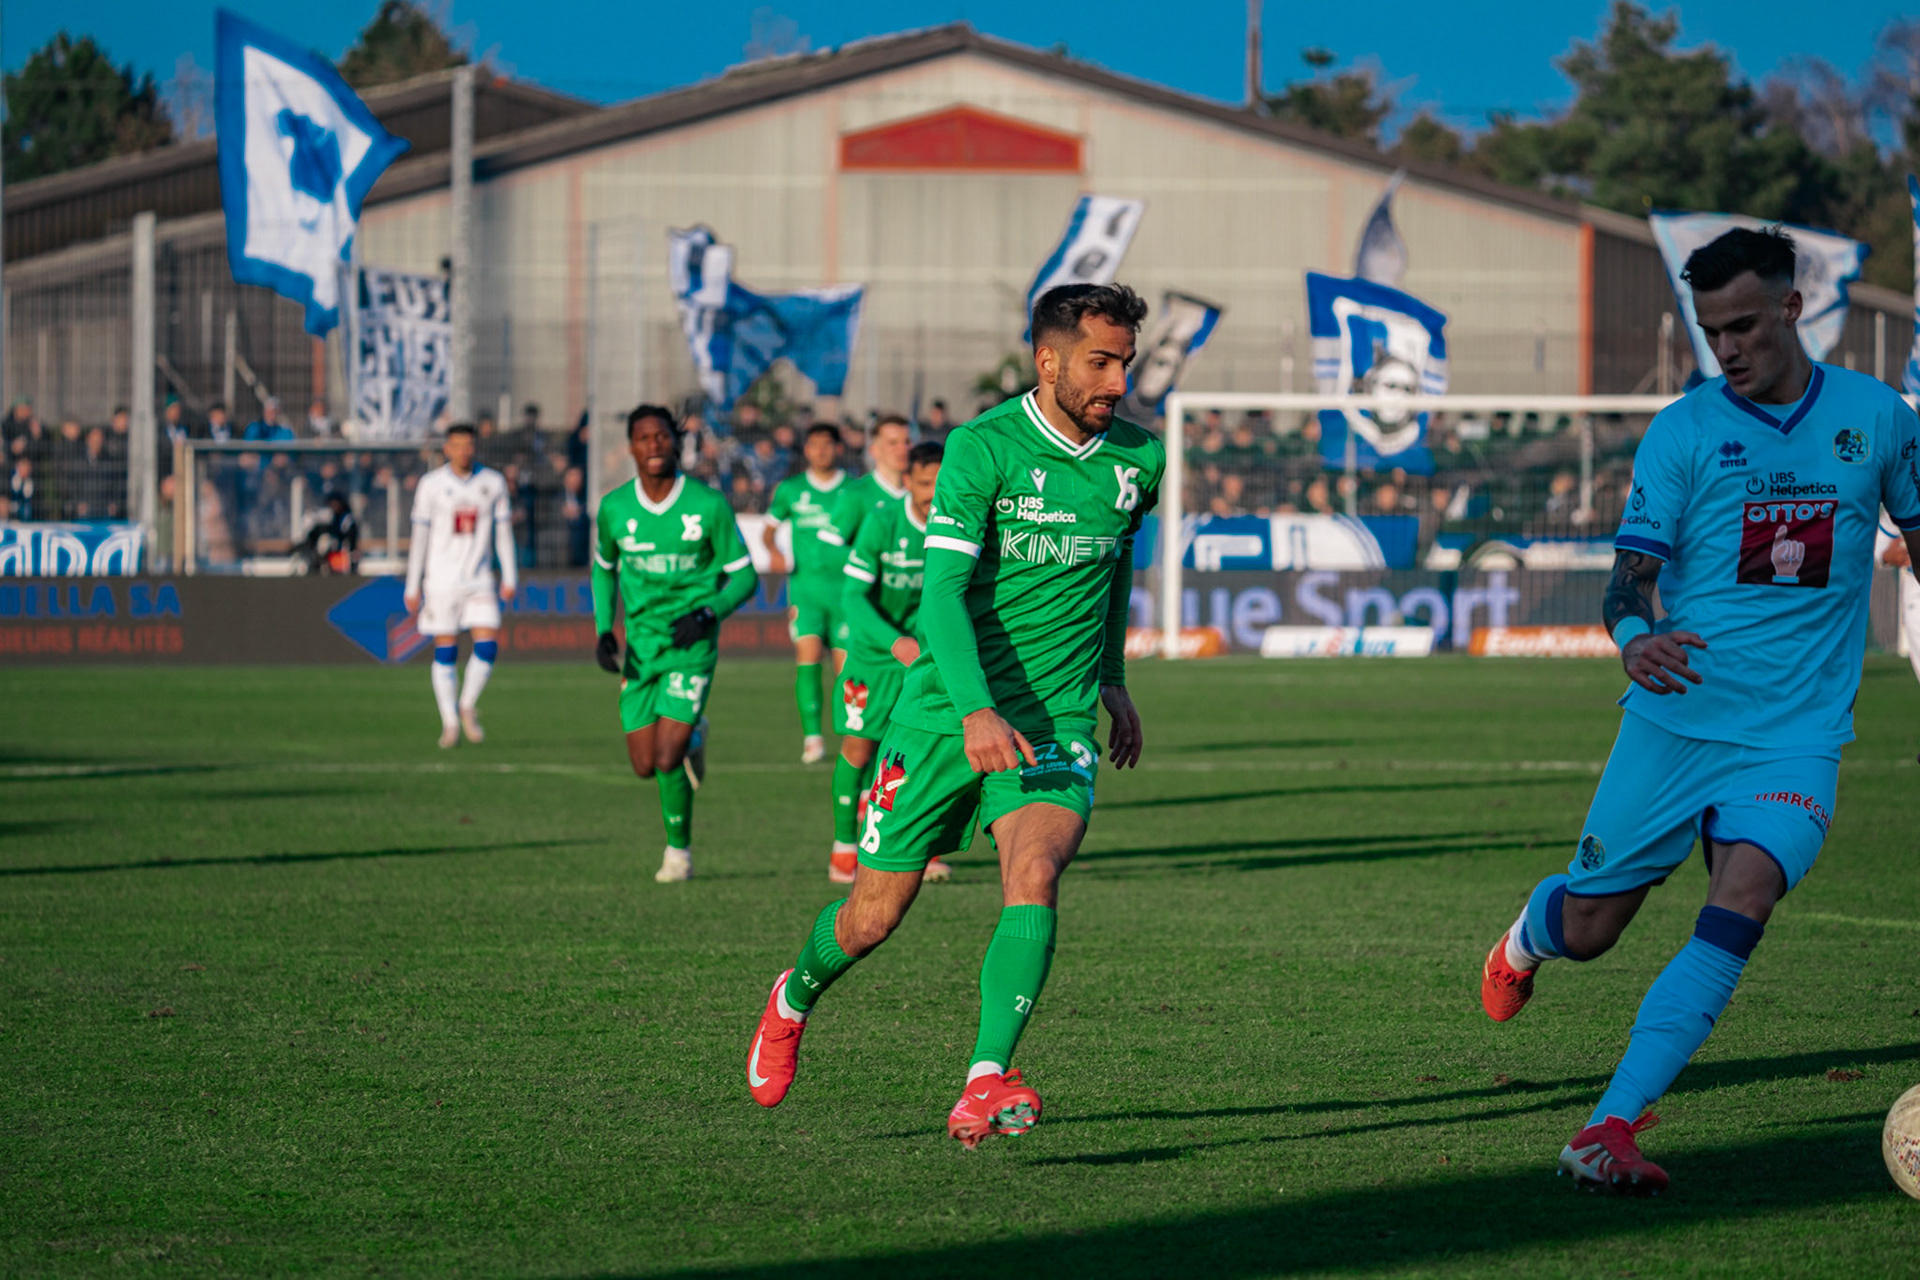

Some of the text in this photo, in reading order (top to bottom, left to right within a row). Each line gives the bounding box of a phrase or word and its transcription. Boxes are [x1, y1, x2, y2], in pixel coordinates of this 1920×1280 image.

[1720, 458, 1747, 468] errea
[1769, 472, 1796, 484] UBS
[1769, 482, 1838, 498] Helpetica
[1018, 496, 1044, 509] UBS
[1017, 507, 1076, 525] Helpetica
[1748, 502, 1834, 523] OTTO'S
[1000, 528, 1117, 566] KINET
[1014, 995, 1033, 1015] 27
